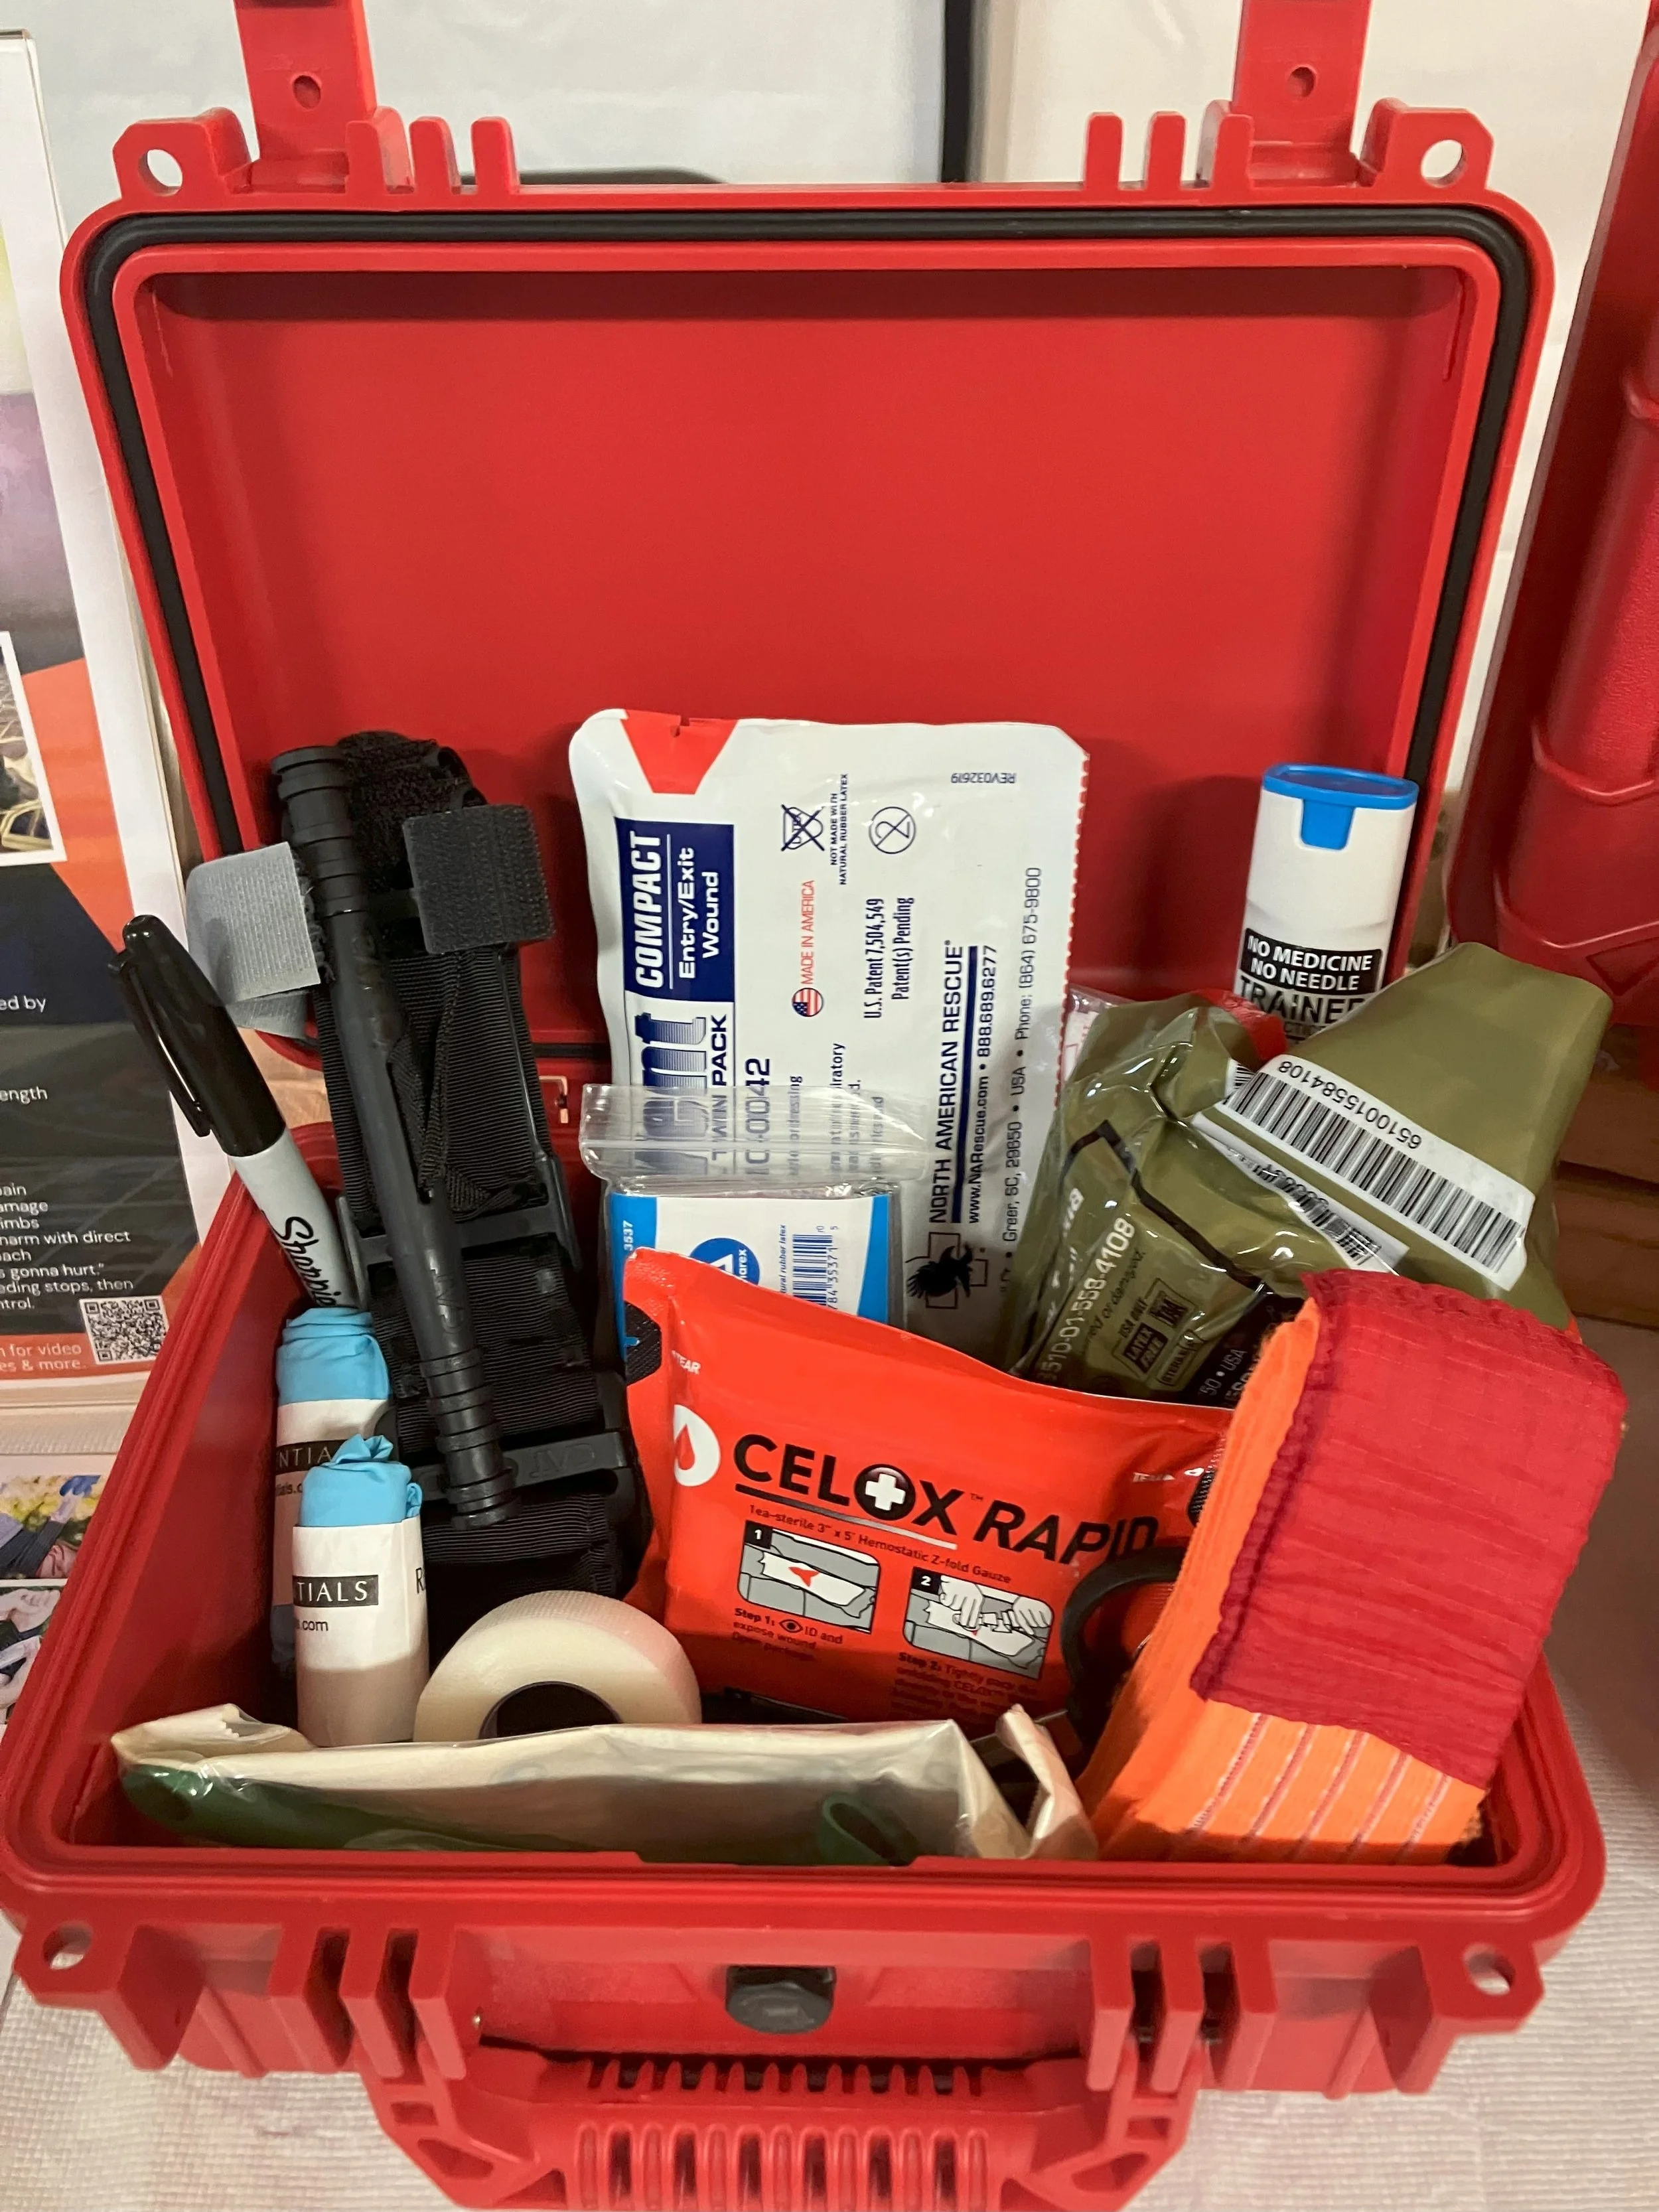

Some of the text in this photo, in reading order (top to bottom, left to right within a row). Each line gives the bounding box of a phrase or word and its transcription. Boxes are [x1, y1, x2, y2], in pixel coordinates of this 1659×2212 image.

[951, 773, 1016, 785] REV032619
[630, 830, 664, 988] COMPACT
[677, 847, 699, 979] Entry/Exit
[701, 871, 719, 958] Wound
[1022, 867, 1042, 945] 675-9800
[801, 881, 815, 984] MADE IN AMERICA
[891, 897, 915, 1000] Patent(s) Pending
[863, 898, 886, 1019] U.S. Patent 7,504,549
[1019, 950, 1036, 989] (864)
[1248, 935, 1373, 972] NO MEDICINE
[1251, 958, 1360, 991] NO NEEDLE
[23, 995, 46, 1013] by
[1015, 995, 1033, 1040] Phone:
[711, 1014, 727, 1086] PACK
[829, 1043, 846, 1089] iratory
[935, 1041, 958, 1151] AMERICAN
[968, 945, 997, 1224] www.NARescue.com 888.689.6277
[1011, 1067, 1026, 1096] USA
[1278, 1061, 1423, 1149] 6510015584108
[1006, 1122, 1023, 1168] 29650
[930, 1159, 952, 1223] NORTH
[43, 1231, 78, 1244] with
[83, 1230, 131, 1244] direct
[623, 1220, 634, 1251] 3537
[1003, 1202, 1019, 1242] Greer,
[0, 1248, 32, 1262] ach
[11, 1267, 59, 1281] gonna
[738, 1248, 748, 1279] arex
[44, 1282, 93, 1295] stops,
[98, 1280, 134, 1291] then
[10, 1343, 33, 1357] for
[38, 1342, 81, 1357] video
[21, 1359, 34, 1372] &
[38, 1359, 87, 1371] more.
[1198, 1378, 1222, 1396] 50
[1220, 1349, 1248, 1371] USA
[749, 1504, 814, 1531] 1ea-sterile
[858, 1534, 929, 1562] Hemostatic
[930, 1553, 970, 1574] Z-fold
[972, 1564, 1011, 1585] Gauze
[755, 1528, 763, 1540] 1
[920, 1576, 932, 1587] 2
[733, 1621, 774, 1638] expose
[734, 1607, 762, 1623] Step
[804, 1626, 818, 1637] ID
[820, 1631, 843, 1645] and
[899, 1652, 928, 1668] Step
